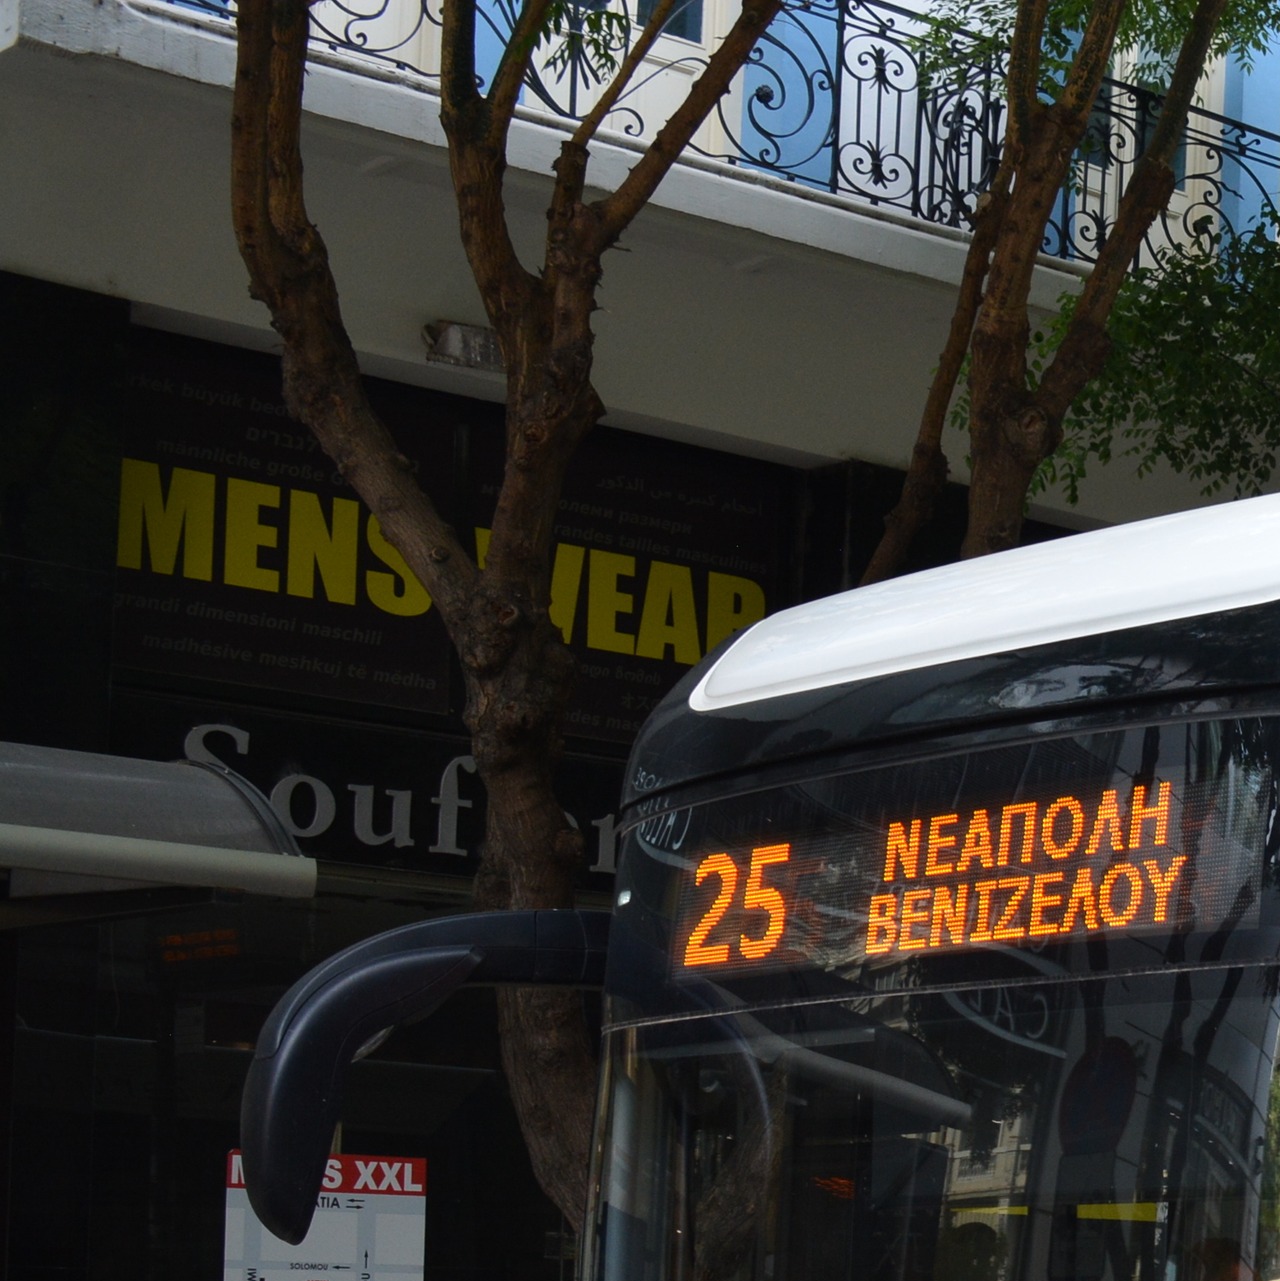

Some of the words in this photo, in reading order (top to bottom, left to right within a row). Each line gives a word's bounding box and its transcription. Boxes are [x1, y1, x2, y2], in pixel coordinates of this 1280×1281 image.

[558, 500, 614, 520] олеми
[186, 600, 296, 632] dimensioni
[302, 619, 383, 646] maschili
[258, 649, 342, 677] meshkuj
[883, 781, 1171, 882] ΝΕΑΠΟΛΗ
[684, 842, 791, 966] 25
[865, 855, 1188, 955] ΒΕΝΙΖΕΛΟΥ
[353, 1160, 423, 1191] XXL
[290, 1262, 329, 1271] SOLOMOU
